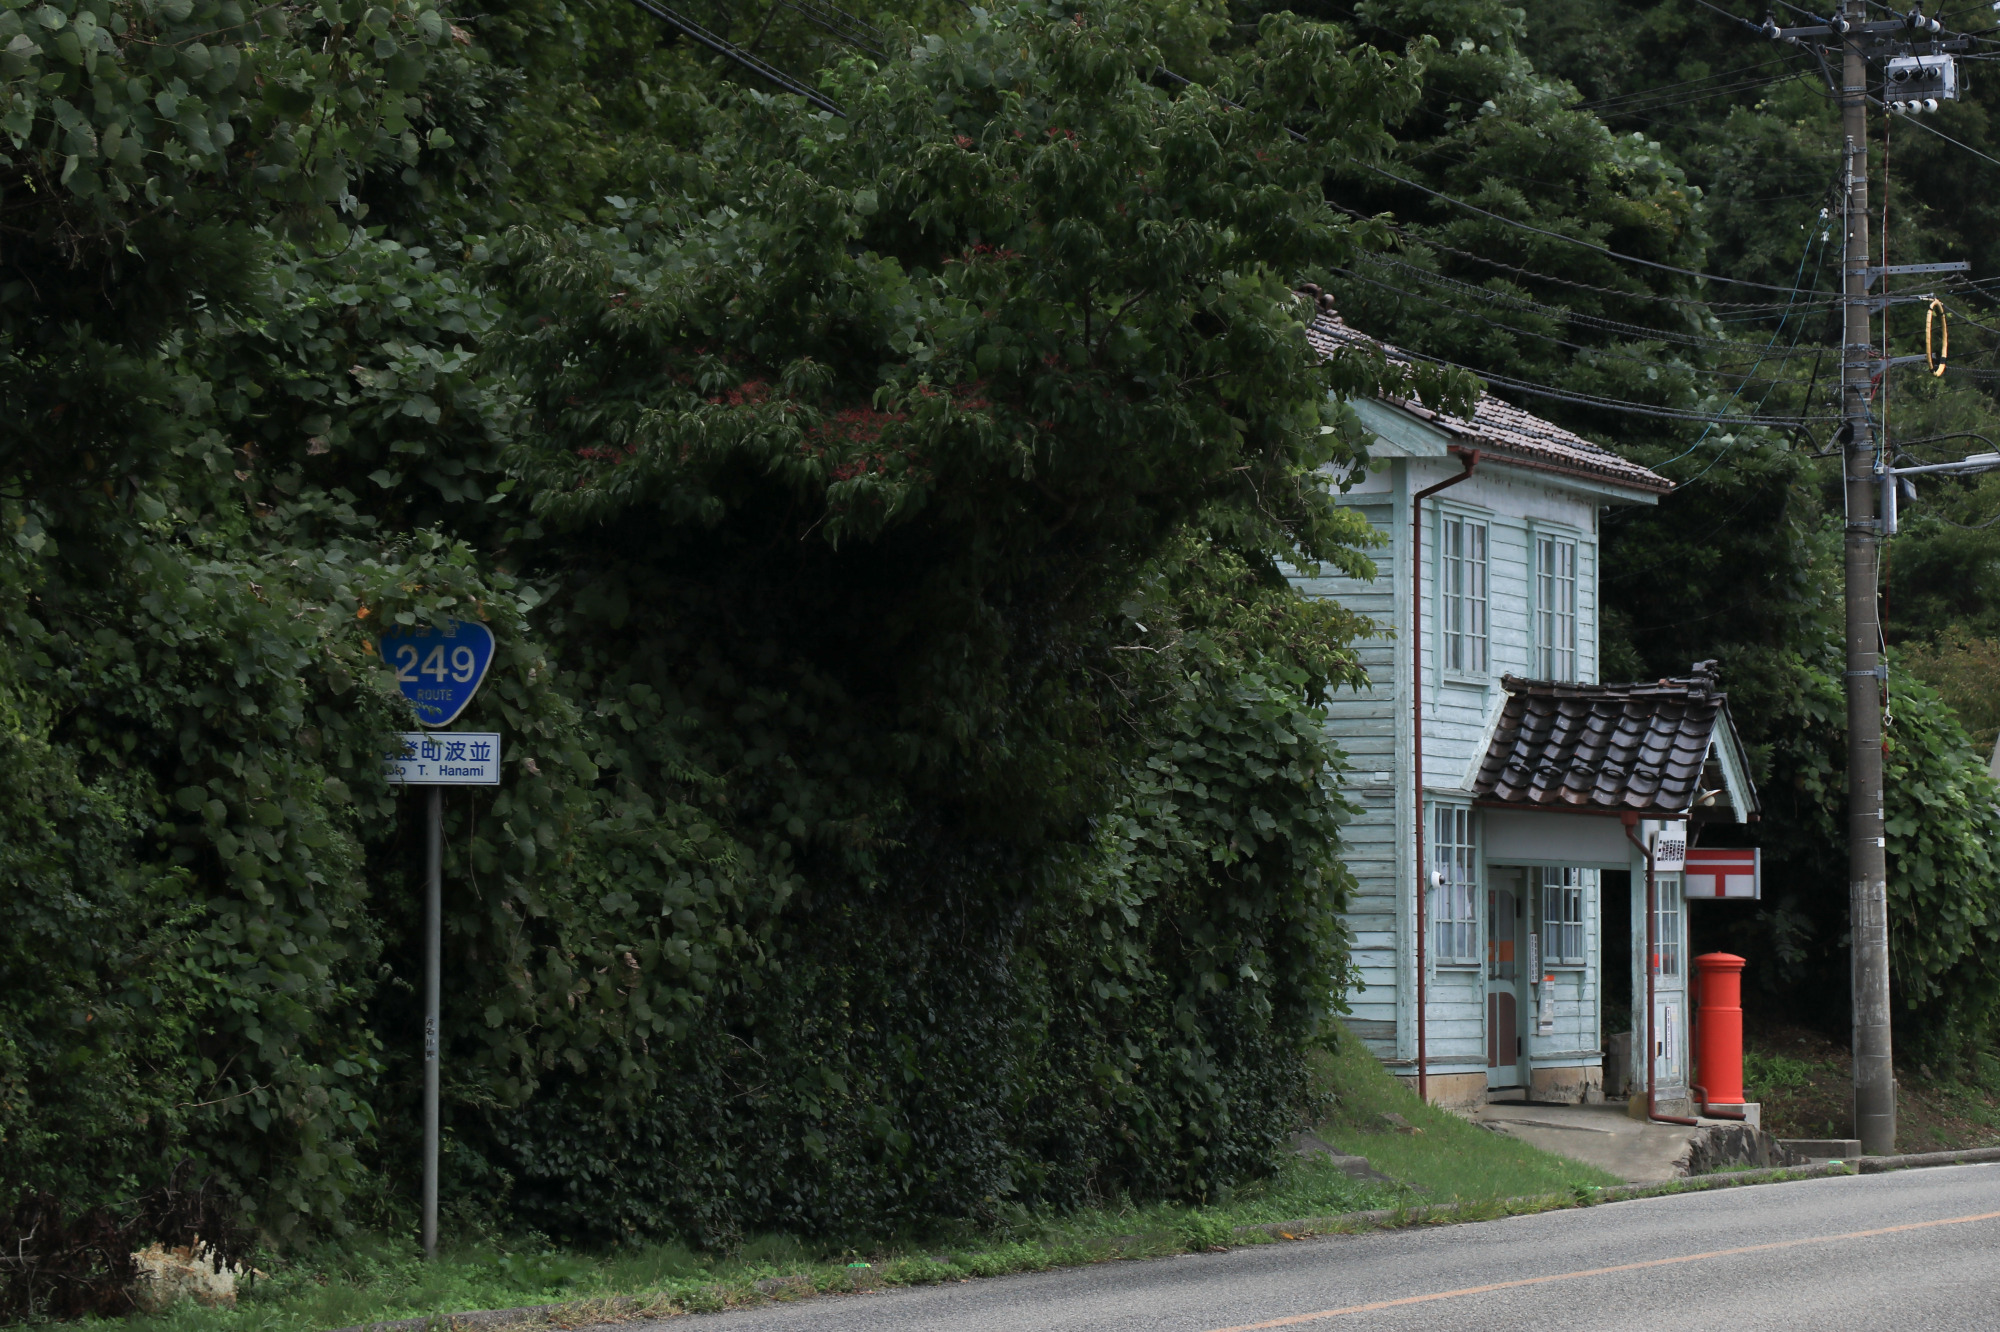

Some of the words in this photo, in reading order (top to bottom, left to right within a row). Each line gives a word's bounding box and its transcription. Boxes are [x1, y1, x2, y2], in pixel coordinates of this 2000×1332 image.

[396, 644, 475, 683] 249
[416, 688, 453, 701] ROUTE
[417, 765, 429, 776] T.
[439, 765, 484, 777] Hanami
